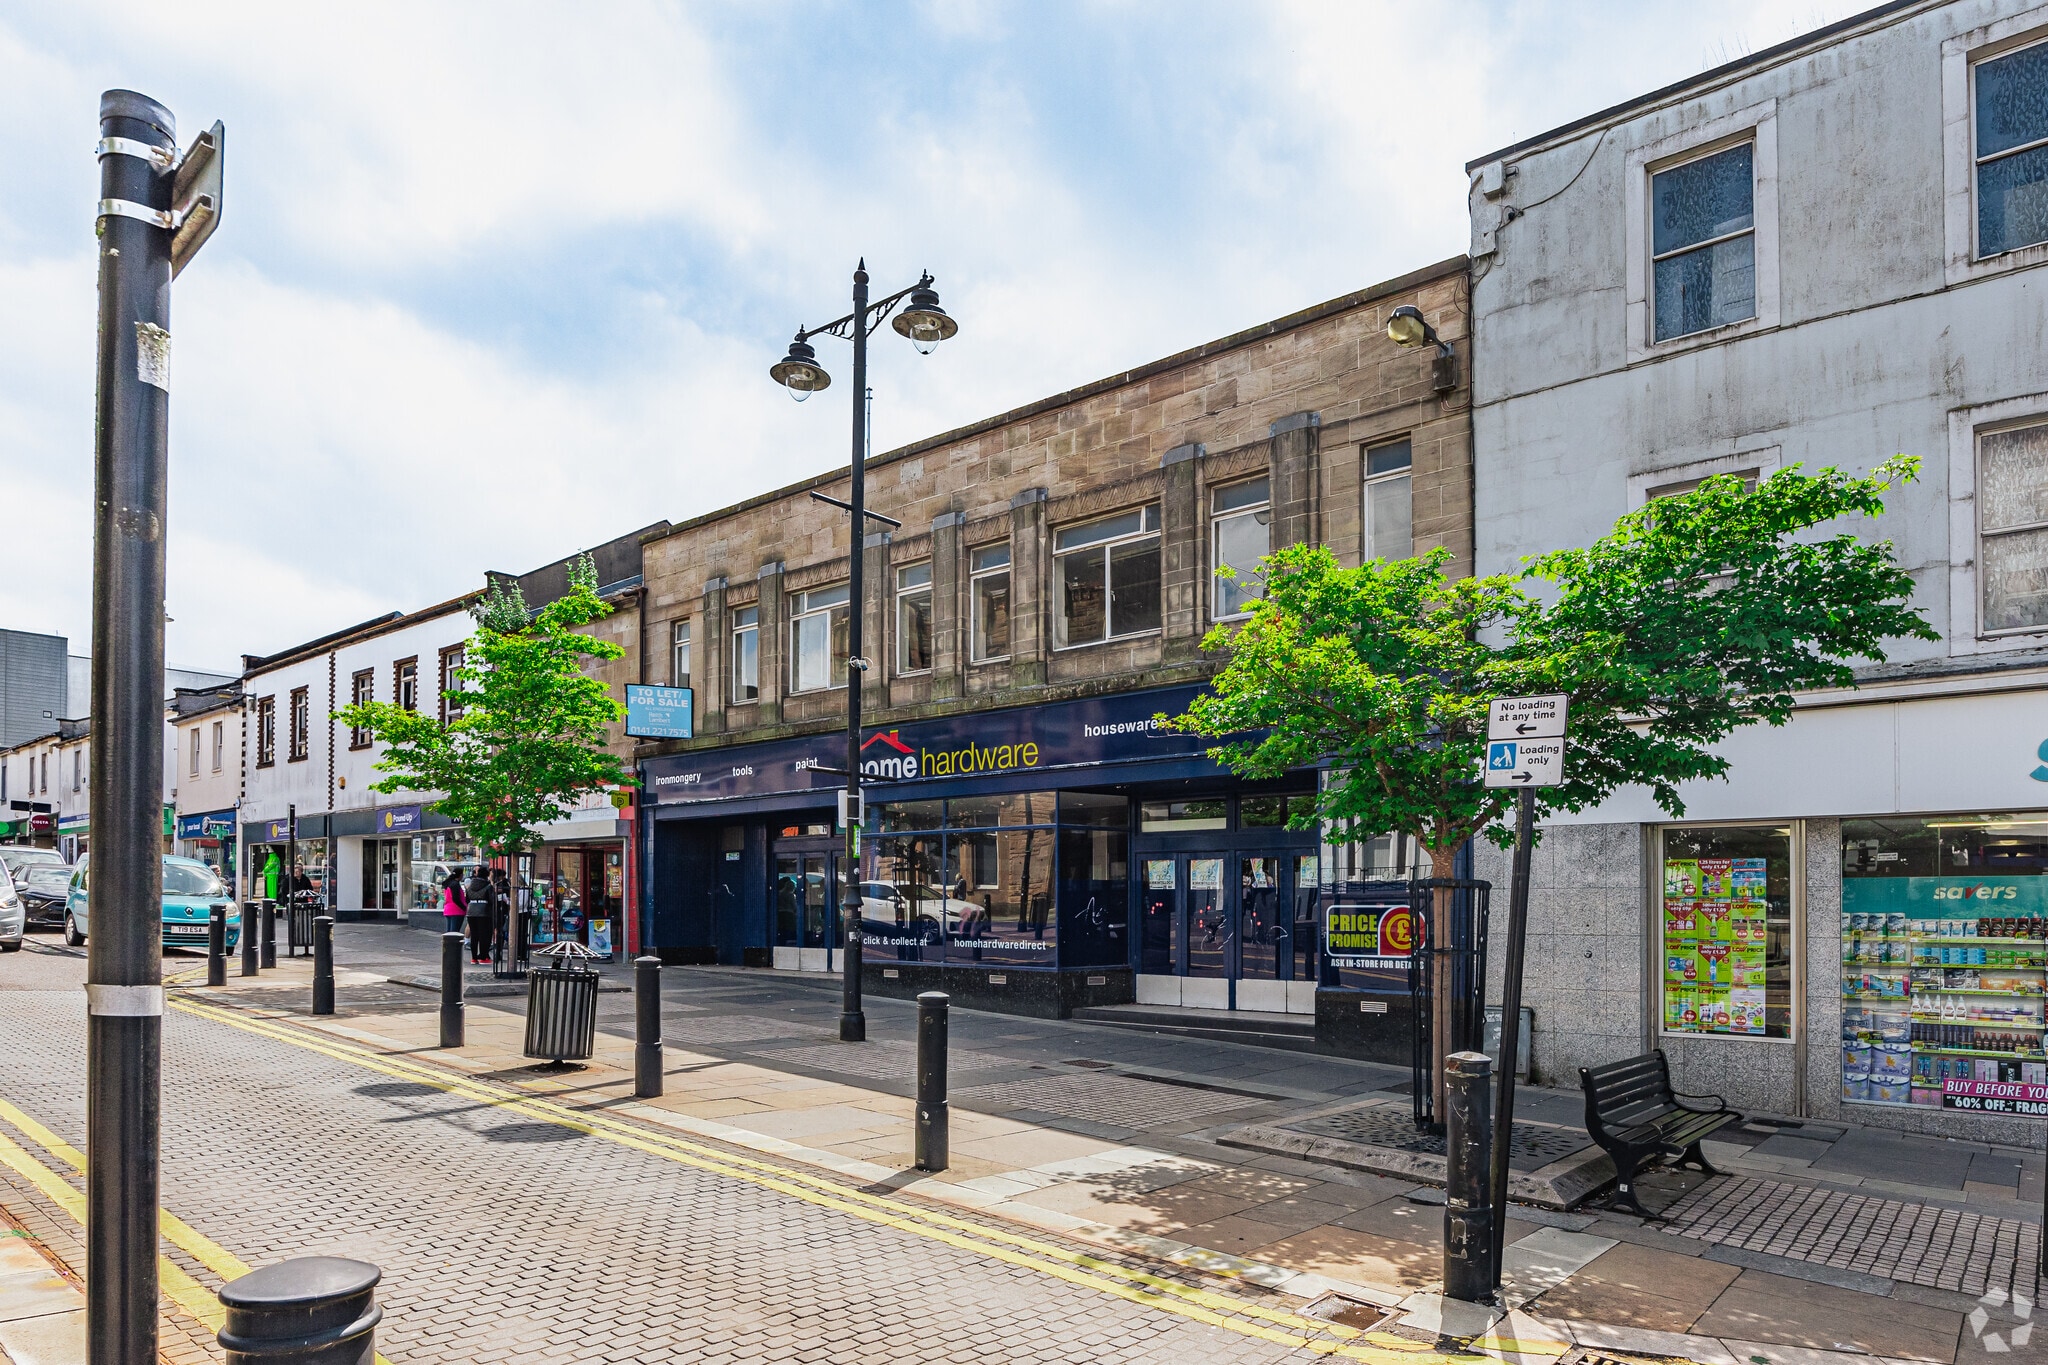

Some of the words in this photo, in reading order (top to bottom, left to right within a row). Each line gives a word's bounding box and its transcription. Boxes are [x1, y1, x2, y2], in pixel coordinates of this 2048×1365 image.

[637, 688, 653, 697] TO
[656, 689, 682, 698] LET/
[630, 696, 655, 706] FOR
[658, 698, 688, 708] SALE
[1501, 703, 1515, 711] No
[1518, 700, 1556, 710] loading
[1499, 713, 1509, 721] at
[1512, 714, 1530, 722] any
[1534, 711, 1556, 719] time
[630, 726, 650, 734] 0141
[668, 728, 688, 736] 7575
[1520, 745, 1559, 754] Loading
[795, 757, 818, 772] paint
[922, 741, 1039, 776] hardware
[1528, 756, 1549, 766] only
[732, 765, 753, 777] tools
[655, 772, 702, 786] ironmongery
[1933, 882, 2018, 900] savers
[1329, 914, 1378, 932] PRICE
[863, 936, 881, 946] click
[882, 936, 888, 945] &
[891, 936, 917, 946] collect
[920, 937, 928, 946] at
[954, 938, 1046, 950] homehardwaredirect
[1329, 933, 1378, 948] PROMISE
[1330, 958, 1345, 967] ASK
[1346, 959, 1378, 968] IN-STORE
[1380, 960, 1393, 968] FOR
[1946, 1080, 1972, 1093] BUY
[1976, 1083, 2022, 1096] BEFORE
[1955, 1096, 1981, 1109] 60%
[1984, 1099, 2006, 1111] OFF
[2016, 1101, 2048, 1115] FRAG
